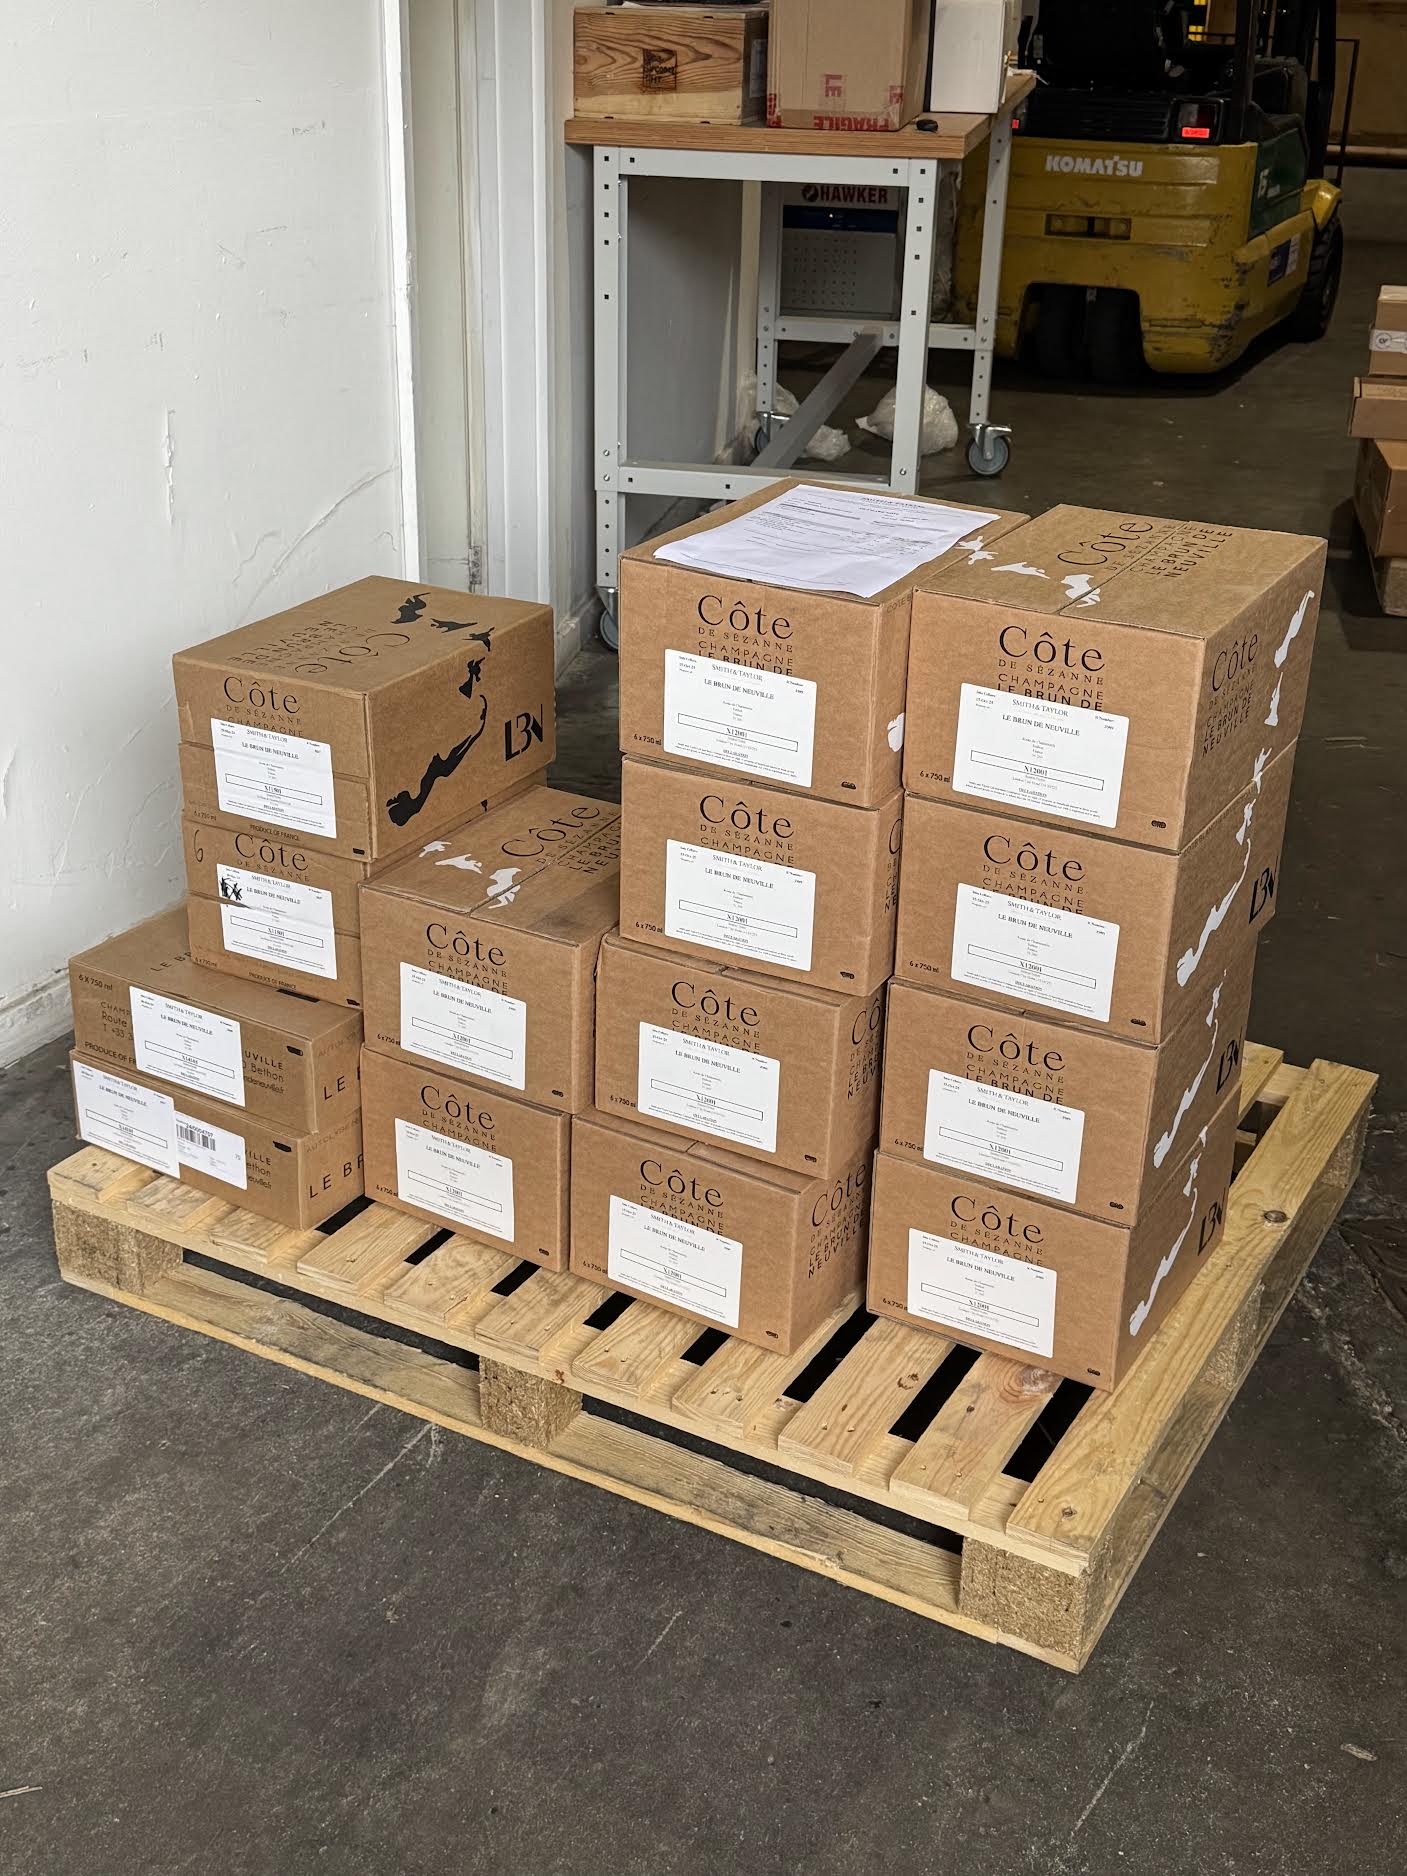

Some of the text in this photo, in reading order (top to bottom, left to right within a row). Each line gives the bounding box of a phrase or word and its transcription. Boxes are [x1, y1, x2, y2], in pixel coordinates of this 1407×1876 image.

[1045, 155, 1143, 177] KOMATSU
[820, 186, 888, 204] HAWKER
[698, 595, 793, 639] Côte
[699, 627, 792, 652] DE SÉZANNE
[1000, 626, 1105, 672] Côte
[699, 641, 793, 666] CHAMPAGNE
[998, 659, 1016, 669] DE
[1212, 634, 1258, 691] Côte
[224, 677, 300, 713] Côte
[713, 681, 731, 689] BRUN
[743, 687, 774, 700] NEUVILLE
[998, 674, 1103, 700] CHAMPAGNE
[1024, 688, 1071, 705] BRUN
[1081, 700, 1102, 711] DE
[226, 705, 239, 713] DE
[1013, 716, 1032, 726] BRUN
[1045, 723, 1080, 736] NEUVILLE
[643, 735, 655, 744] 750
[273, 749, 299, 759] NEUVILLE
[930, 772, 943, 781] 750
[700, 795, 794, 838] Côte
[502, 808, 600, 856] Côte
[700, 824, 793, 851] DE SÉZANNE
[193, 829, 204, 863] 6
[235, 833, 308, 871] Côte
[701, 837, 794, 864] CHAMPAGNE
[984, 835, 1086, 881] Côte
[714, 870, 731, 878] BRUN
[743, 877, 773, 889] NEUVILLE
[983, 865, 1000, 875] DE
[983, 878, 1084, 908] CHAMPAGNE
[1008, 916, 1027, 926] BRUN
[1028, 922, 1037, 930] DE
[1039, 925, 1073, 938] NEUVILLE
[427, 923, 506, 966] Côte
[427, 949, 441, 958] DE
[429, 961, 508, 989] CHAMPAGNE
[919, 963, 932, 973] 750
[441, 993, 455, 1001] BRUN
[465, 1000, 491, 1013] NEUVILLE
[672, 981, 760, 1026] Côte
[672, 1008, 687, 1017] DE
[102, 1011, 127, 1027] Route
[672, 1020, 760, 1050] CHAMPAGNE
[84, 1042, 117, 1057] PRODUCE
[967, 1052, 983, 1062] DE
[968, 1025, 1065, 1071] Côte
[251, 1063, 285, 1082] Bethon
[684, 1053, 700, 1062] BRUN
[711, 1060, 741, 1073] NEUVILLE
[966, 1065, 1064, 1097] CHAMPAGNE
[991, 1080, 1033, 1097] BRUN
[1043, 1094, 1063, 1105] DE
[421, 1086, 495, 1129] Côte
[977, 1101, 995, 1111] BRUN
[997, 1106, 1006, 1114] DE
[1008, 1109, 1040, 1123] NEUVILLE
[423, 1120, 496, 1151] CHAMPAGNE
[641, 1160, 723, 1207] Côte
[641, 1184, 655, 1194] DE
[641, 1196, 724, 1230] CHAMPAGNE
[952, 1196, 1044, 1243] Côte
[950, 1221, 967, 1231] DE
[950, 1232, 1043, 1266] CHAMPAGNE
[956, 1260, 972, 1269] BRUN
[984, 1268, 1015, 1281] NEUVILLE
